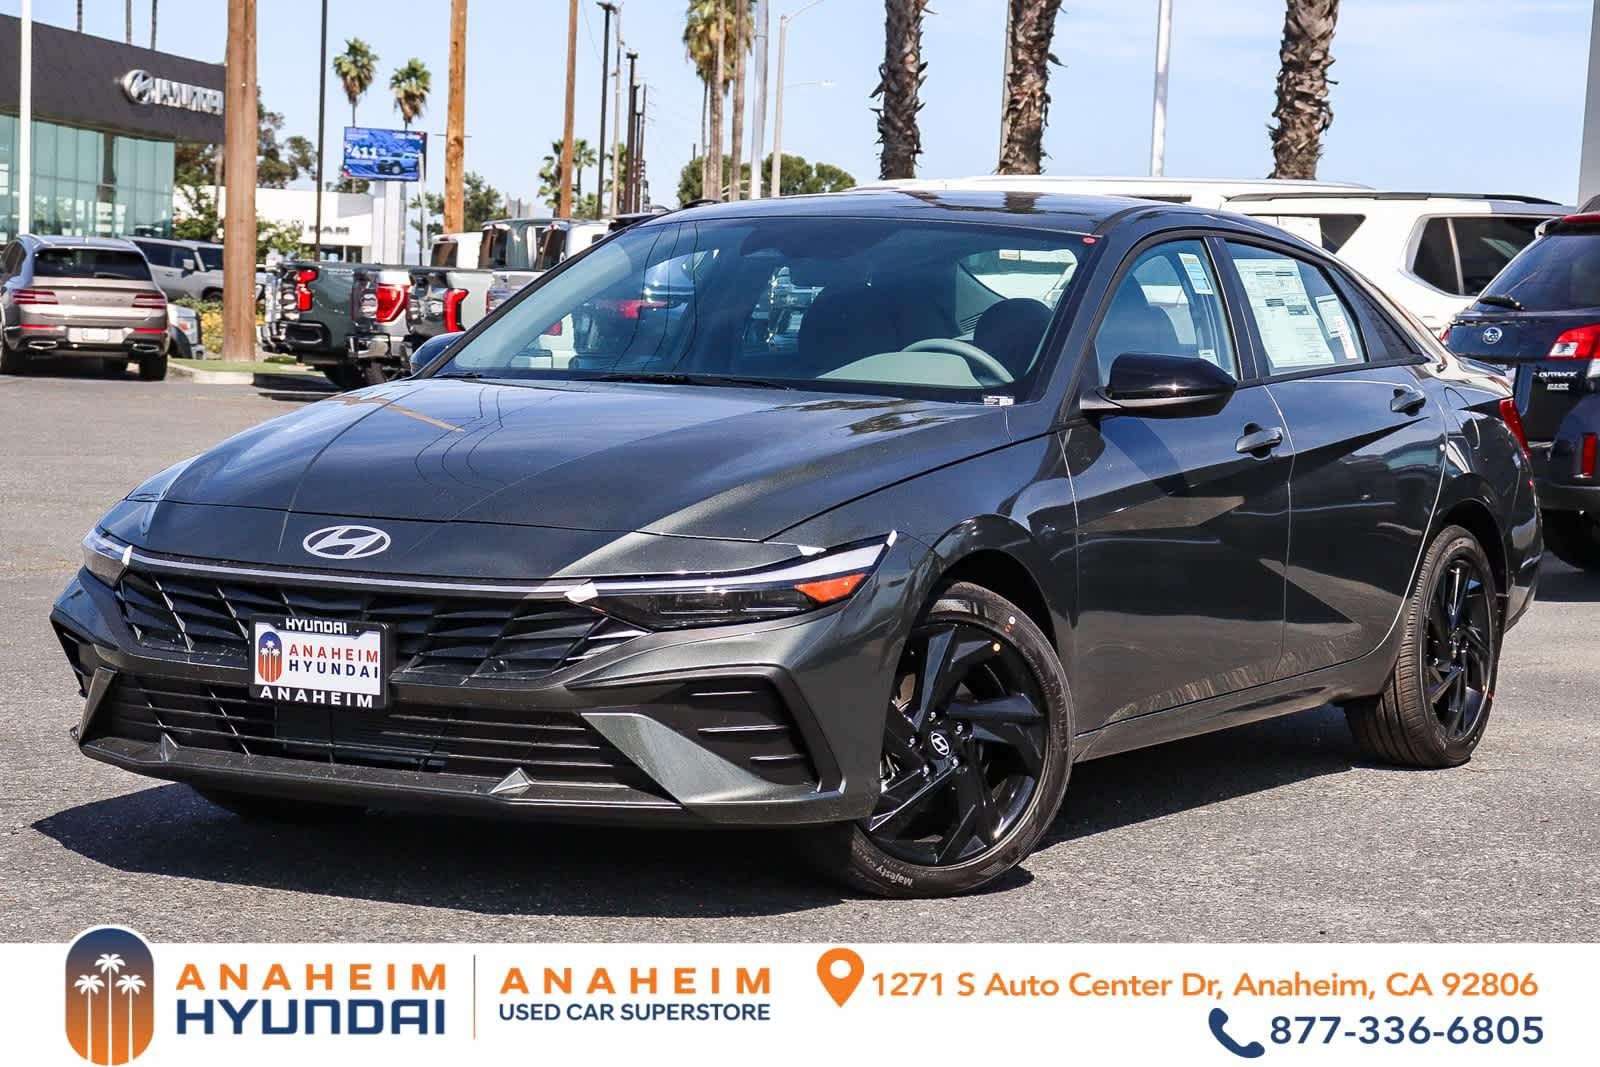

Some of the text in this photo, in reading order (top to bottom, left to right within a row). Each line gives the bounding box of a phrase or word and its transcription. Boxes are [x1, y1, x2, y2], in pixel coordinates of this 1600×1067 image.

[285, 618, 347, 634] HYUNDAI
[289, 643, 379, 663] ANAHEIM
[288, 659, 379, 678] HYUNDAI
[260, 685, 373, 708] ANAHEIM
